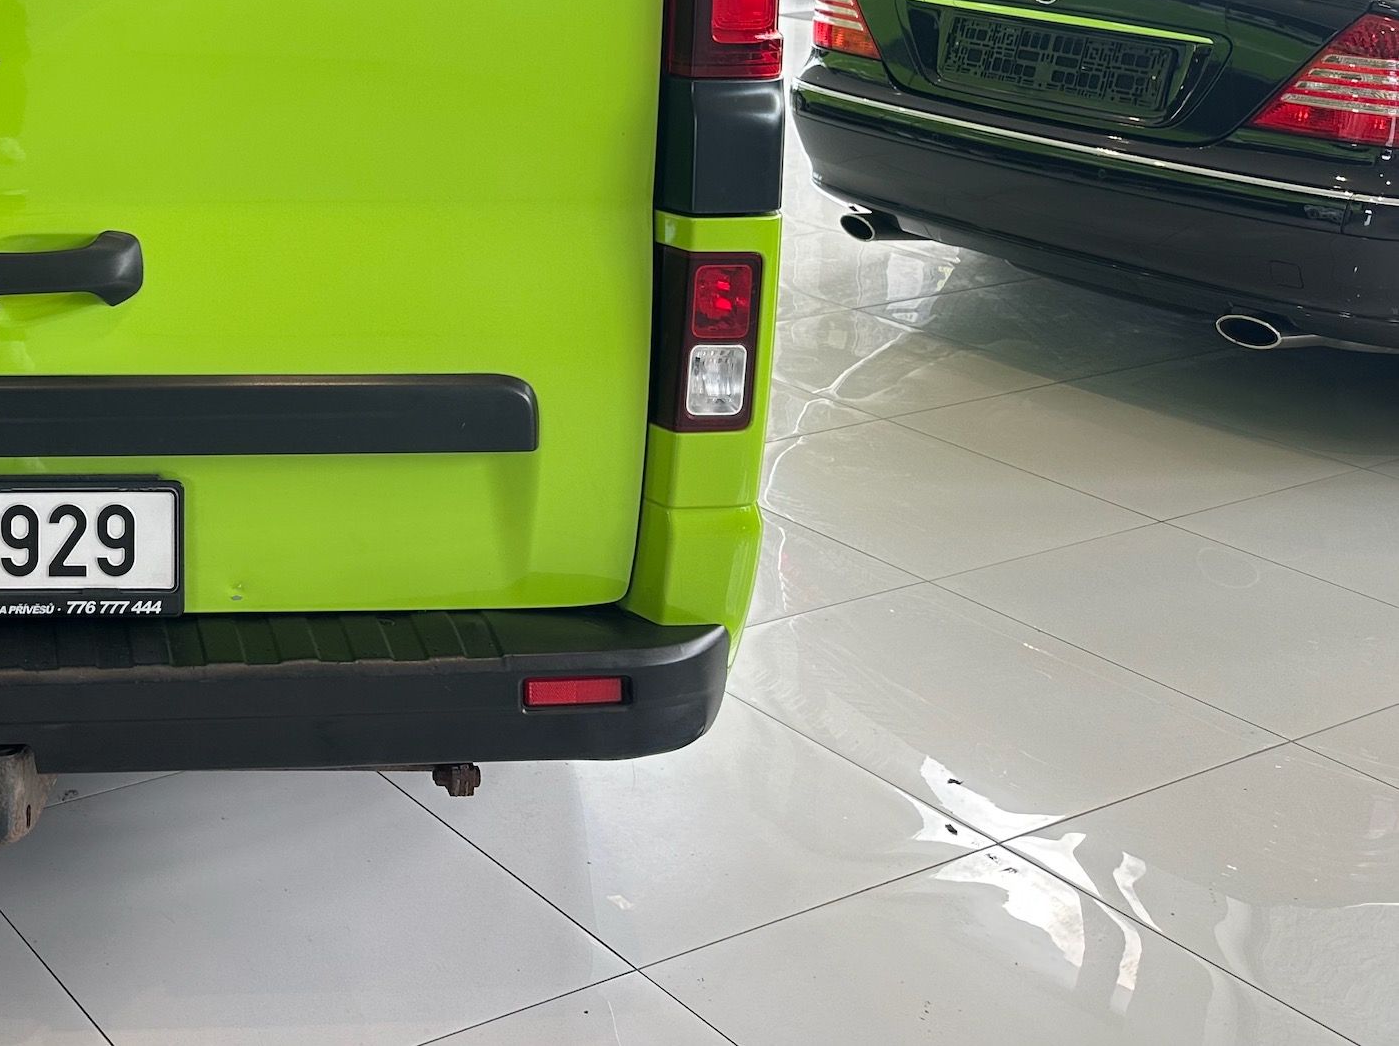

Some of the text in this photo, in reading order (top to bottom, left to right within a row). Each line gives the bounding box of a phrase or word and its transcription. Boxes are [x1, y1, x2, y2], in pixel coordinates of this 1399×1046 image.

[8, 602, 54, 615] PŘÍVĚSŮ
[66, 600, 96, 614] 776
[99, 600, 130, 614] 777
[131, 600, 162, 614] 444
